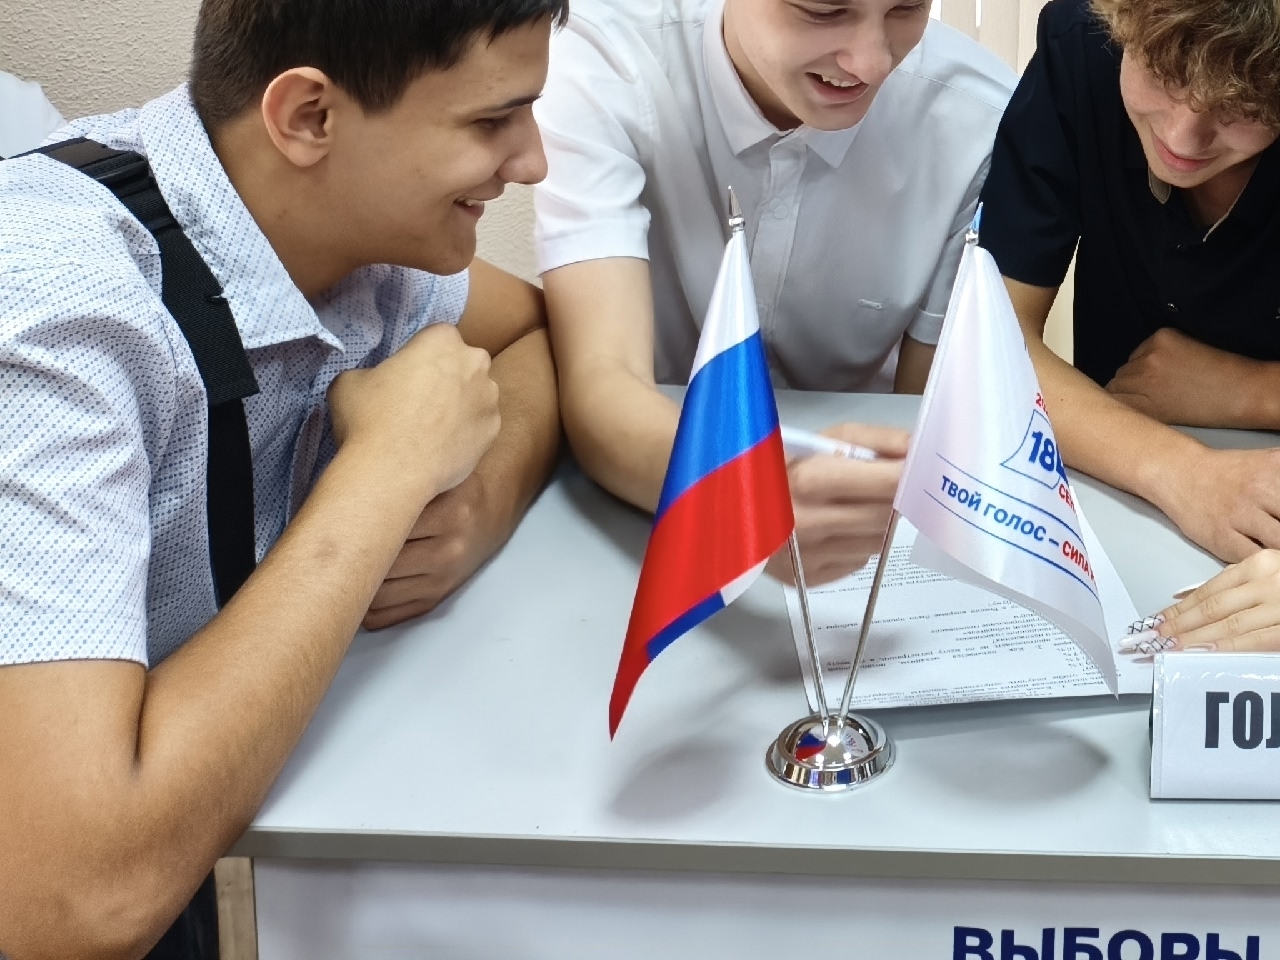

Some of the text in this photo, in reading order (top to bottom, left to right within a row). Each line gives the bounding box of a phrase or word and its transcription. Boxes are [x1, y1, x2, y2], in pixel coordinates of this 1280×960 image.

[941, 475, 982, 512] ТВОЙ
[983, 503, 1047, 542] ГОЛОС
[1062, 540, 1090, 577] СИЛА
[953, 926, 1260, 960] ВЫБОРЫ
